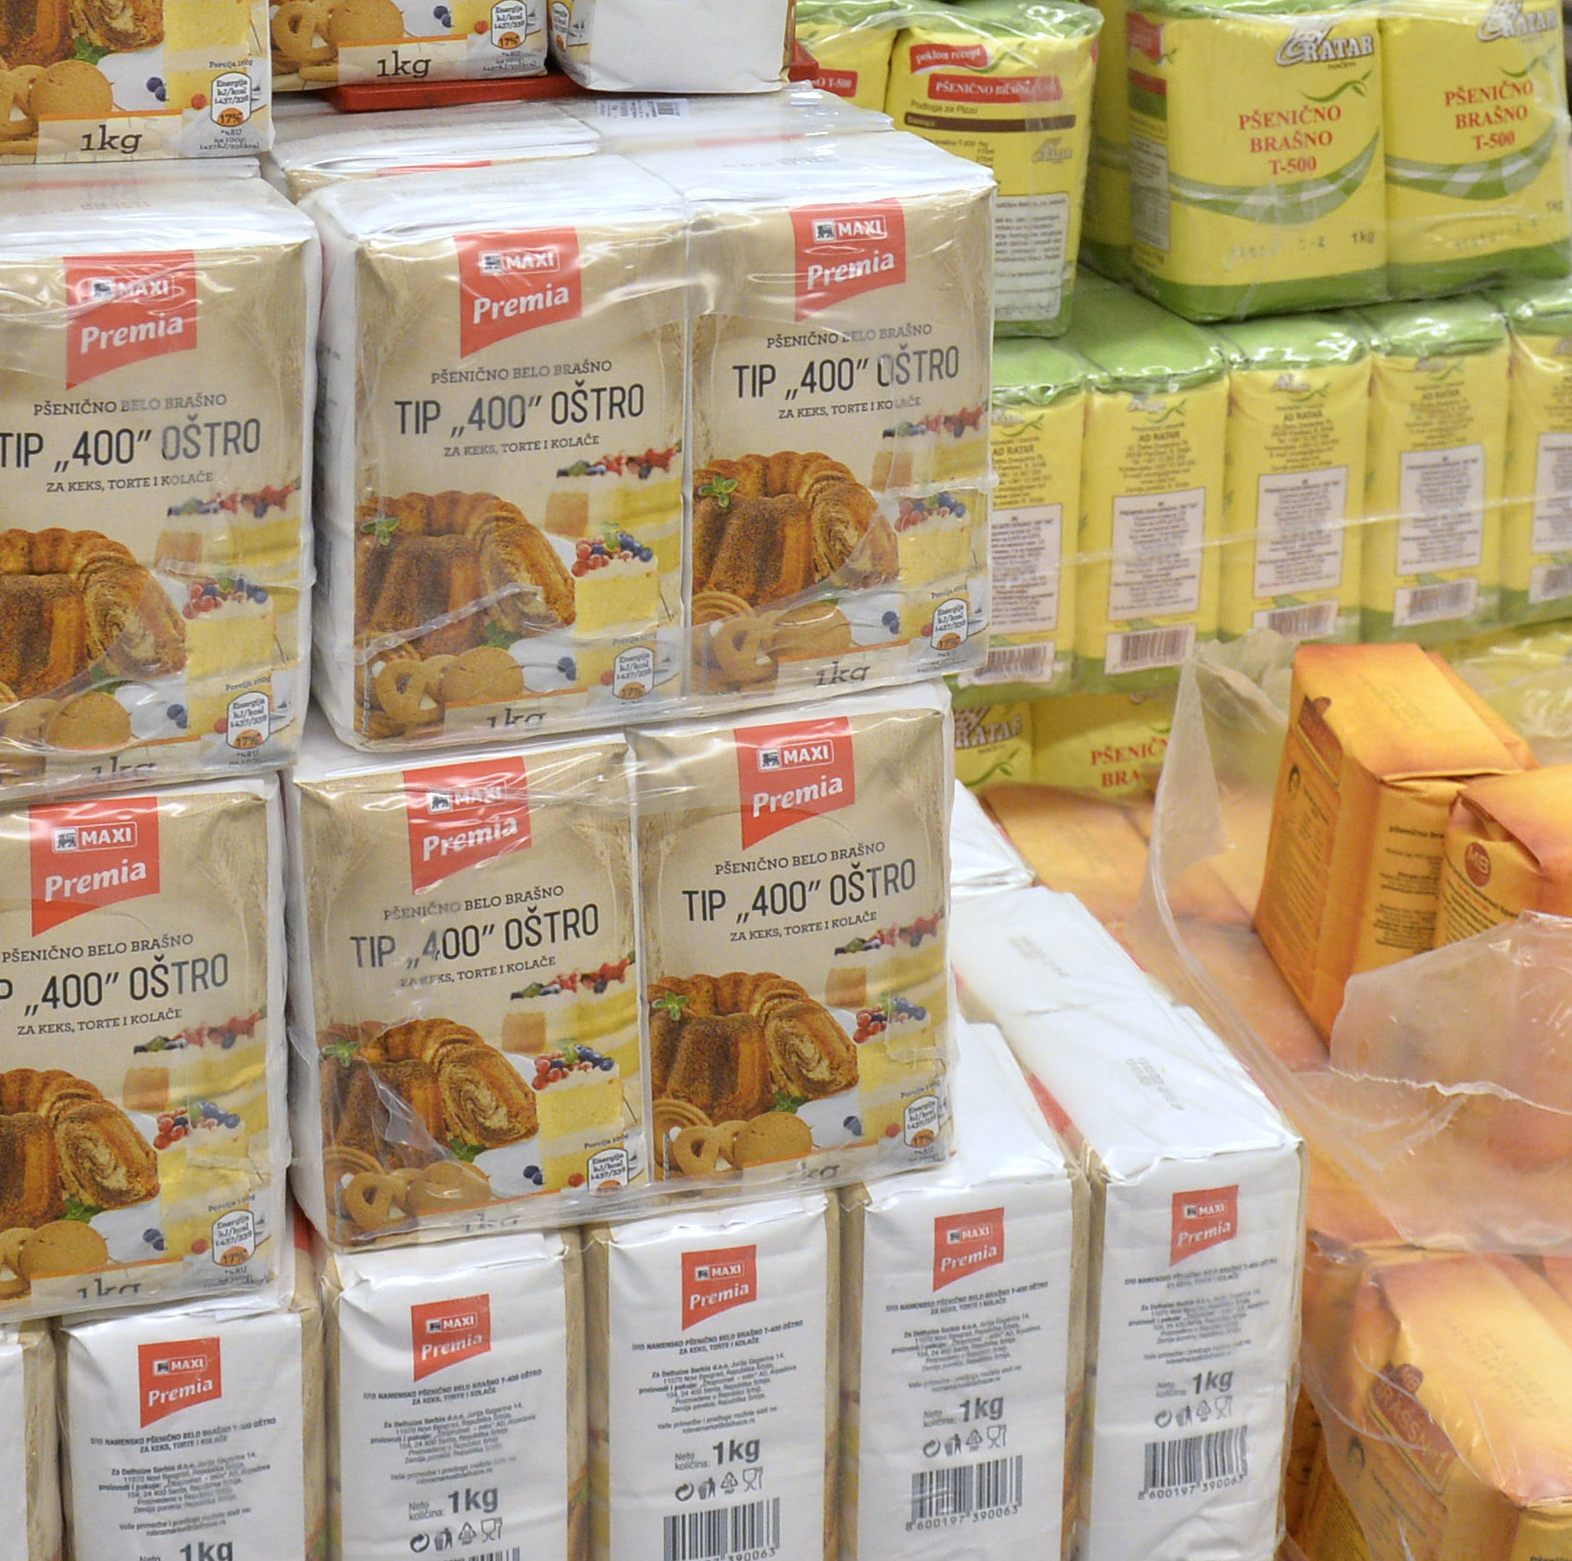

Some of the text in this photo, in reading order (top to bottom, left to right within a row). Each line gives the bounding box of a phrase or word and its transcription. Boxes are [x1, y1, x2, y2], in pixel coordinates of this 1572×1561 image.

[915, 49, 949, 65] poklon
[935, 81, 994, 95] PŠENIČNO
[1445, 79, 1534, 108] PŠENIČNO
[1239, 104, 1341, 131] PŠENIČNO
[1455, 104, 1528, 130] BRAŠNO
[1250, 130, 1333, 154] BRAŠNO
[1472, 130, 1515, 150] T-500
[1269, 155, 1317, 176] T-500
[1352, 231, 1375, 245] 1kg
[782, 743, 830, 765] MAXI
[751, 773, 844, 819] Premia
[714, 839, 886, 876] PŠENIČNO BELO BRAŠNO
[682, 887, 728, 923] TIP
[828, 854, 917, 907] OŠTRO
[1197, 1201, 1226, 1218] MAXI
[961, 1223, 991, 1241] MAXI
[1176, 1219, 1232, 1248] Premia
[711, 1265, 741, 1276] MAXI
[939, 1244, 999, 1273] Premia
[689, 1283, 750, 1310] Premia
[1191, 1368, 1234, 1397] 1kg
[959, 1393, 1005, 1426] 1kg
[712, 1439, 760, 1465] 1kg
